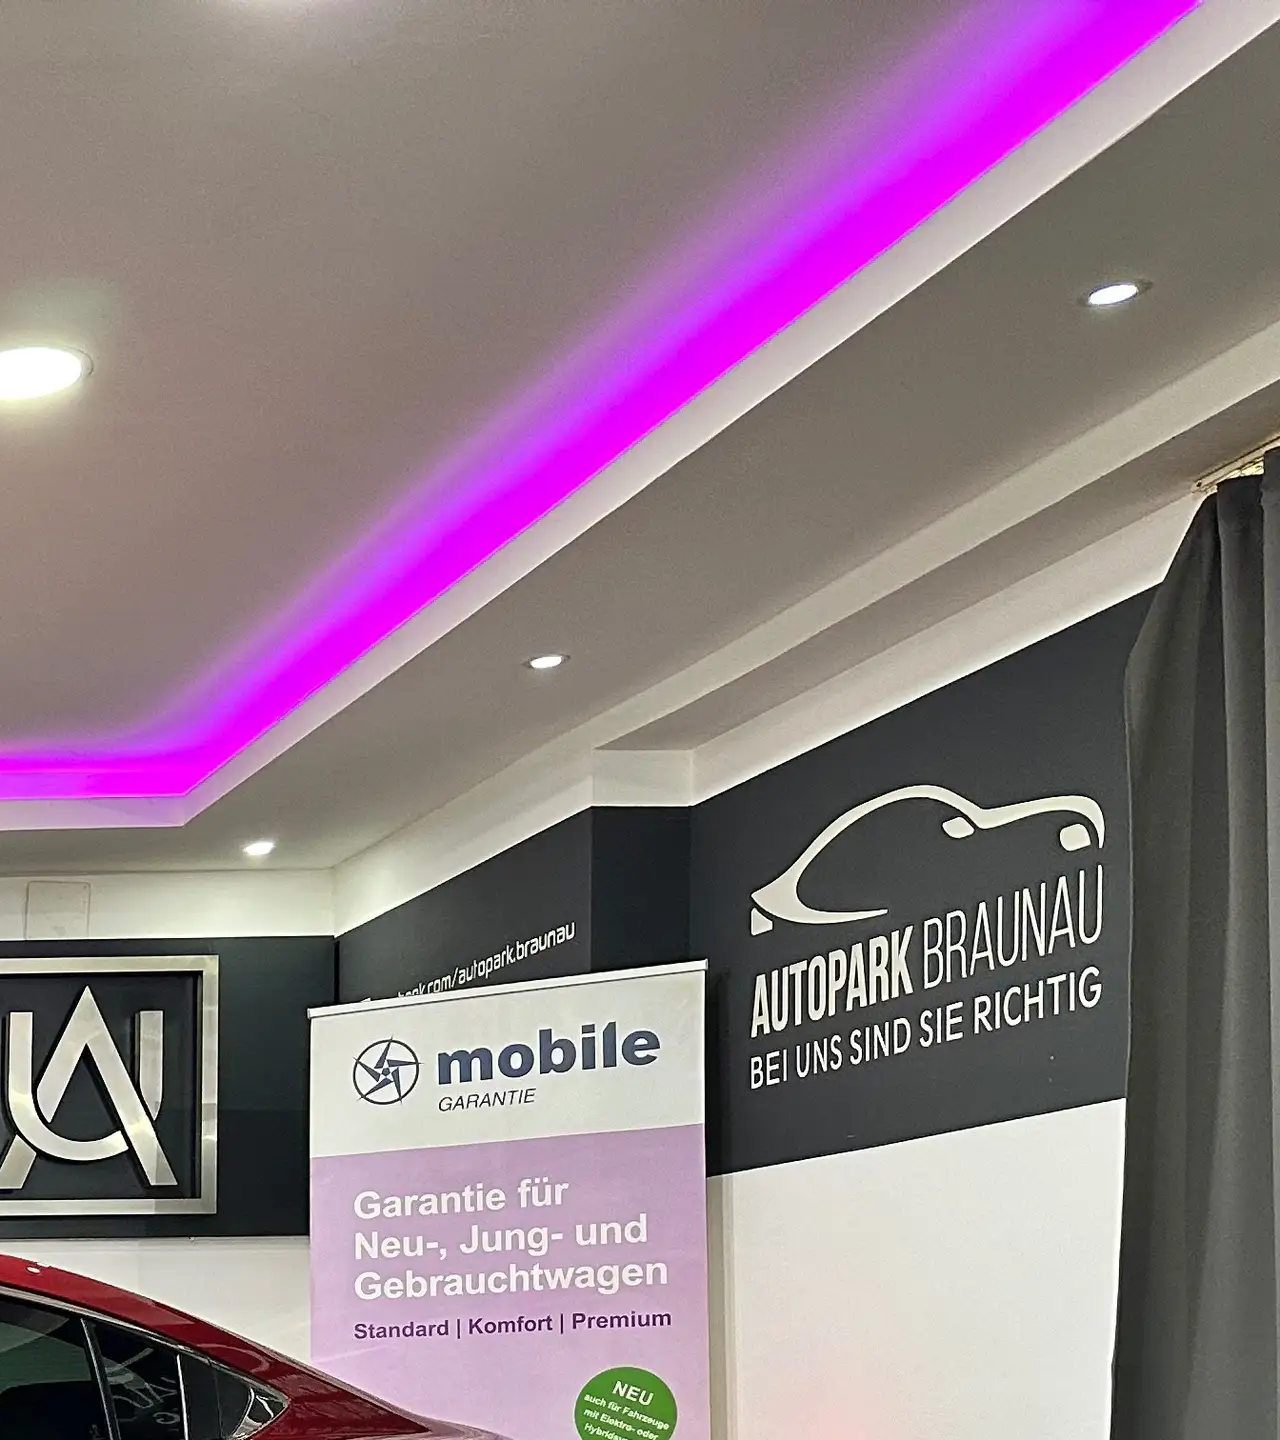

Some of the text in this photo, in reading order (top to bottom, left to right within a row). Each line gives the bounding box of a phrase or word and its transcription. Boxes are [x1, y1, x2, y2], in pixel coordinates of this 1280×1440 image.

[750, 864, 1103, 1038] AUTOPARK BRAUNAU
[750, 966, 1102, 1090] BEI UNS SIND SIE RICHTIG
[437, 1021, 661, 1086] mobile
[438, 1088, 537, 1112] GARANTIE
[353, 1176, 571, 1220] Garantie für
[354, 1213, 648, 1261] Neu-, Jung- und
[353, 1262, 669, 1300] Gebrauchtwagen
[354, 1319, 449, 1340] Standard
[468, 1314, 554, 1335] Komfort
[572, 1310, 672, 1330] Premium
[583, 1393, 670, 1430] auch für Fahrzeuge
[611, 1380, 655, 1406] NEU
[583, 1408, 660, 1440] mit Elektro- oder
